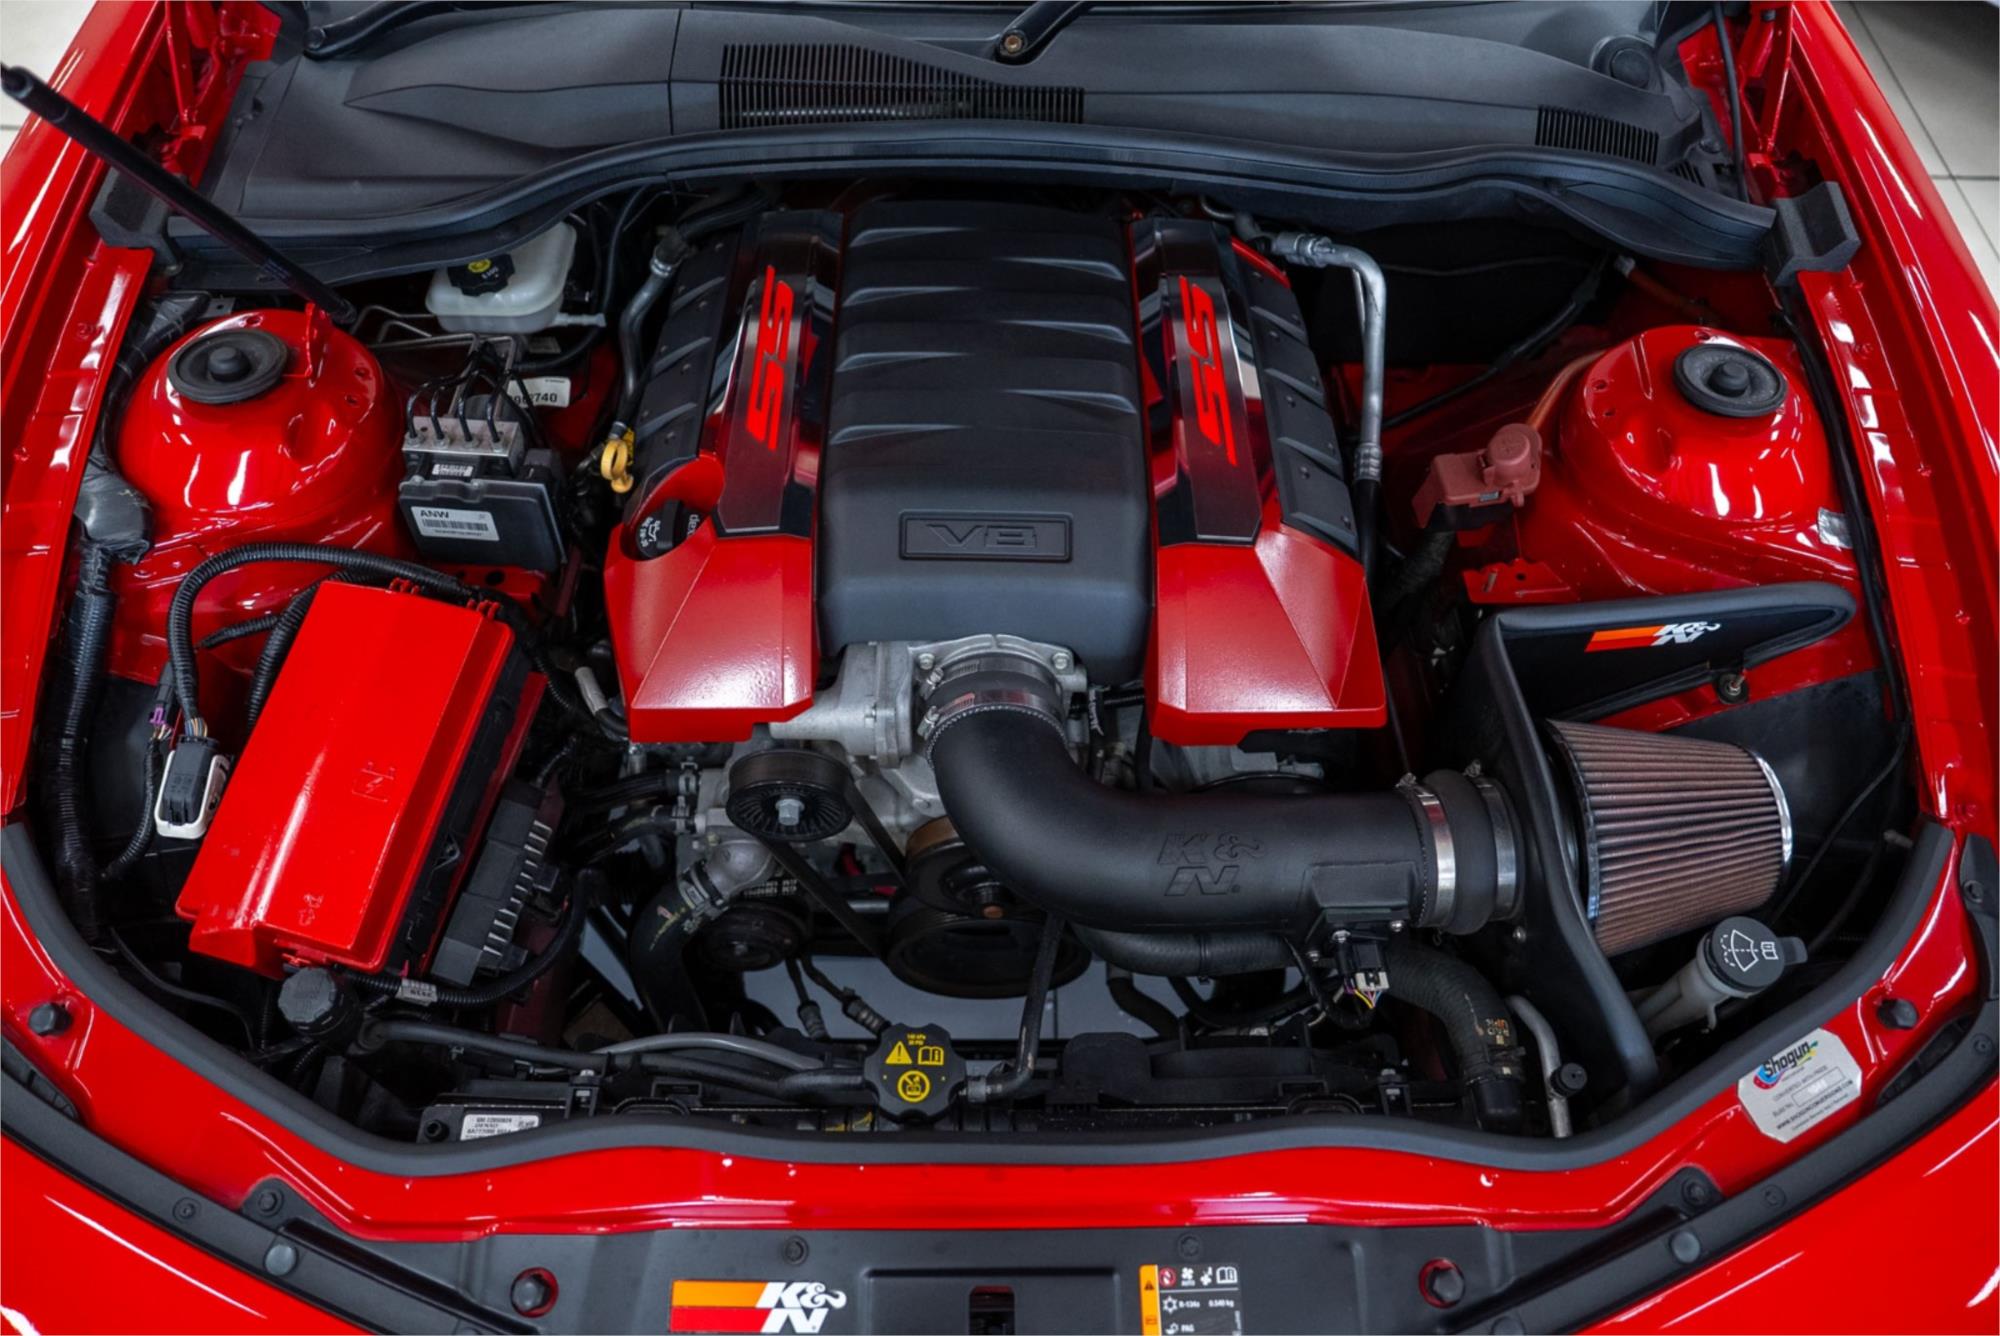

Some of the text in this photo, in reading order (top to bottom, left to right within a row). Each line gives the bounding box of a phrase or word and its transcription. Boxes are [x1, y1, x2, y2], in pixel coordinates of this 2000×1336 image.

[746, 265, 794, 450] SS
[1179, 275, 1238, 466] SS
[420, 510, 449, 518] ANW
[926, 524, 1038, 548] V8
[1763, 1041, 1810, 1078] Shogun
